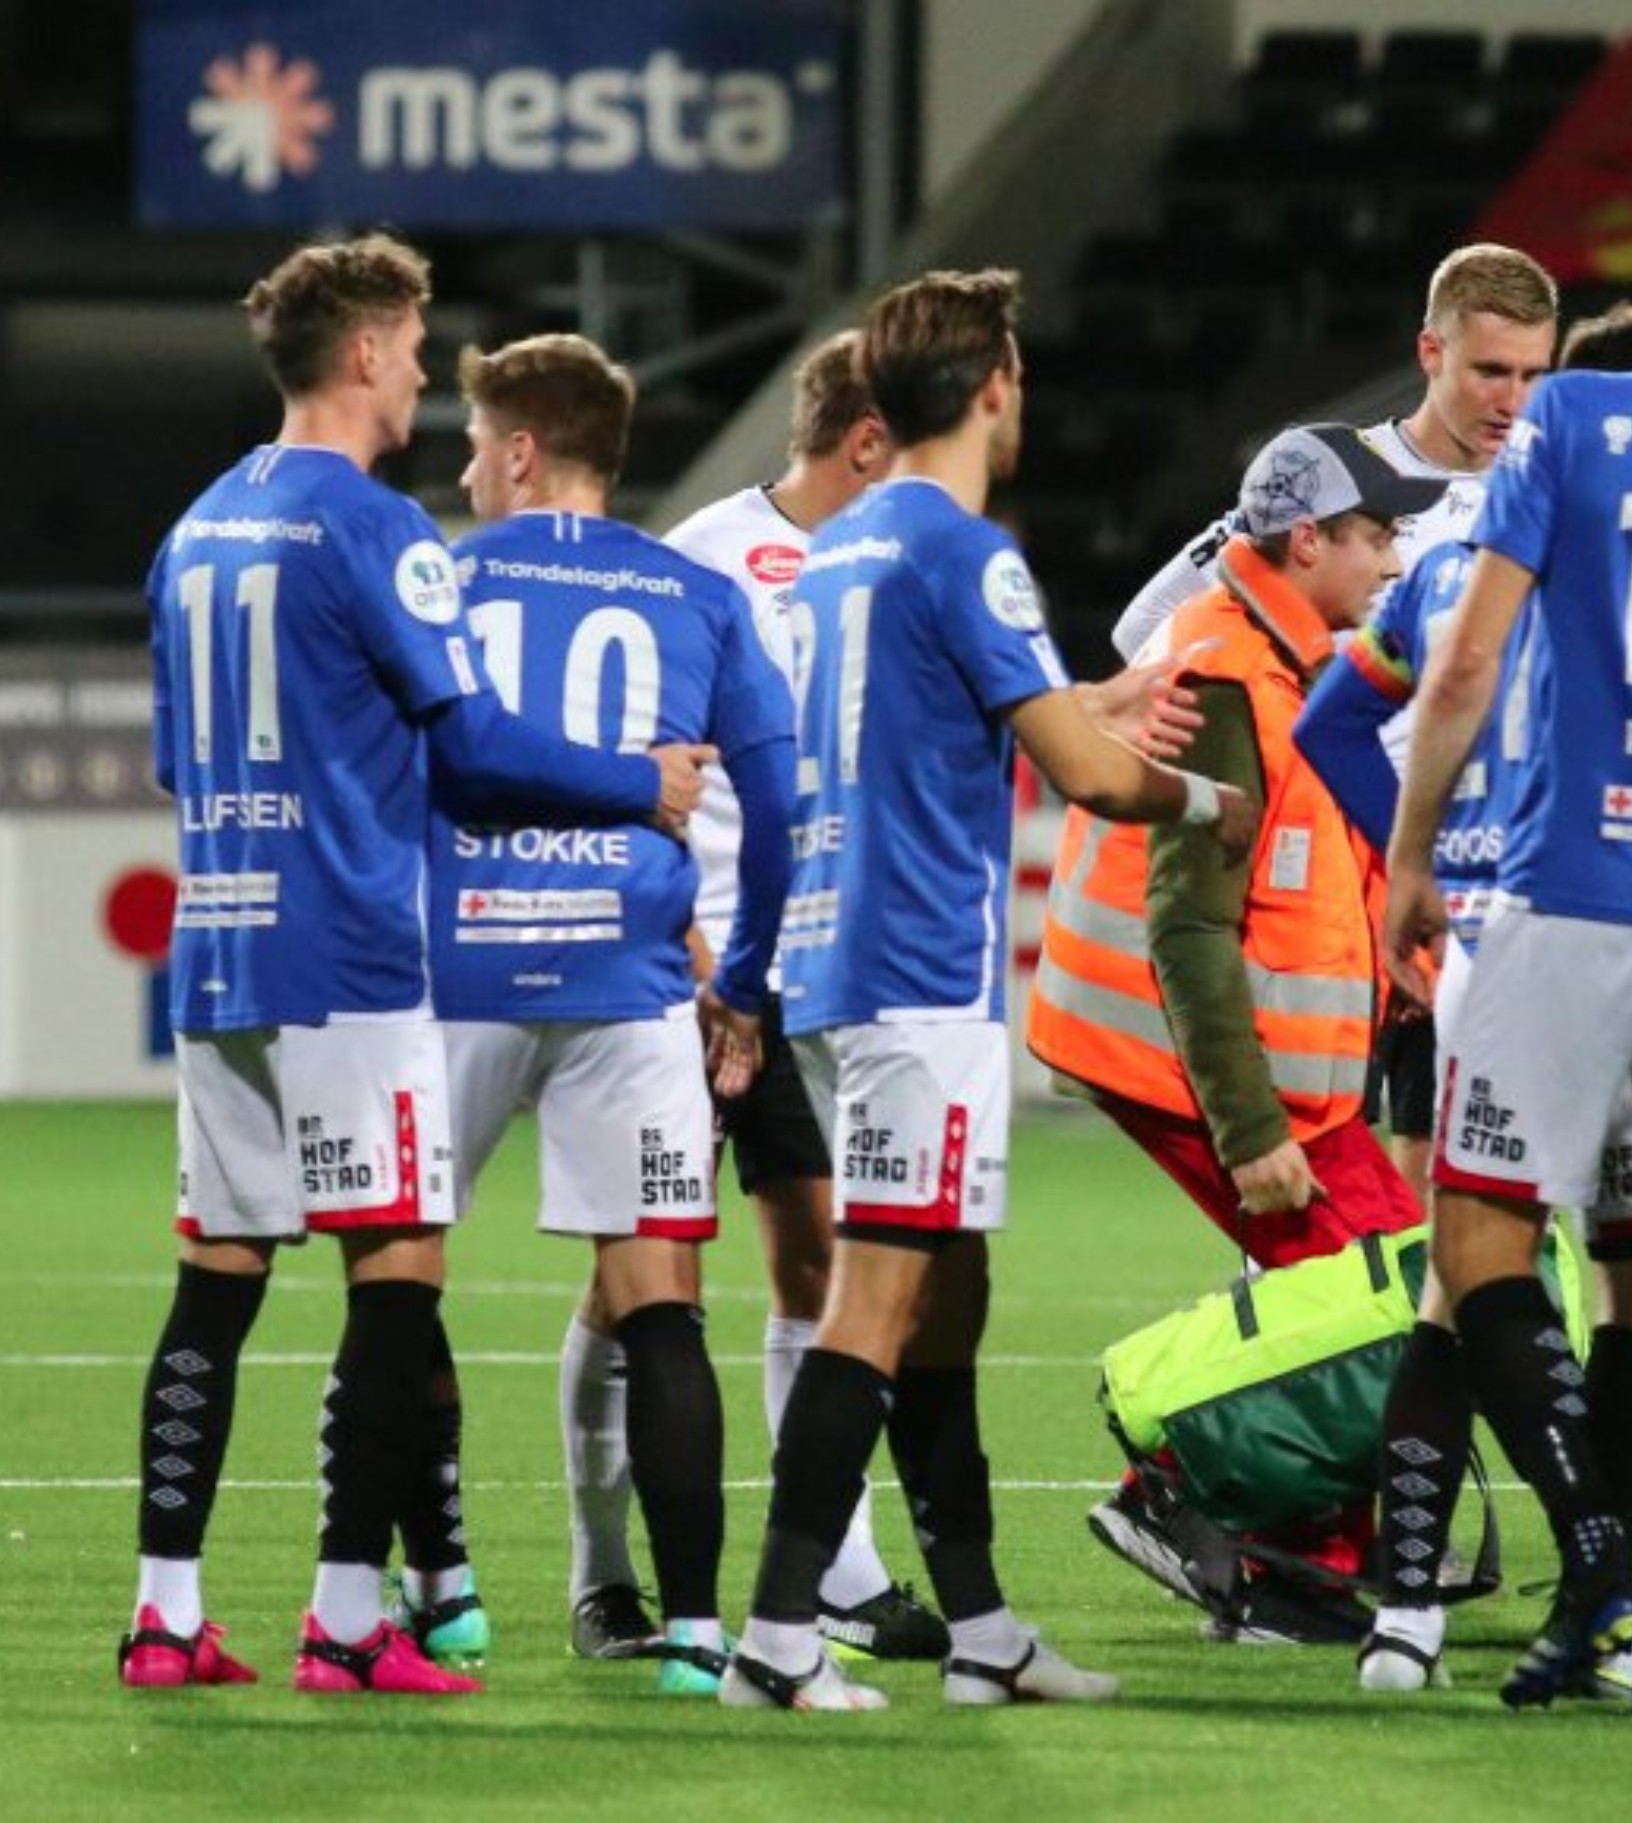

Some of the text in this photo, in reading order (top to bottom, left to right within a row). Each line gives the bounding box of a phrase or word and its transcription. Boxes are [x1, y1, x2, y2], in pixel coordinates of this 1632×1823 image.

[359, 49, 793, 171] mesta
[178, 563, 282, 763] 11
[467, 599, 662, 757] 10
[454, 826, 630, 866] STOKKE
[1464, 1100, 1515, 1130] HOF
[300, 1139, 353, 1164] HOF
[1459, 1126, 1527, 1163] STAD
[303, 1164, 371, 1193] STAD
[641, 1151, 686, 1178] HOF
[844, 1154, 908, 1184] STAD
[641, 1178, 702, 1206] STAD
